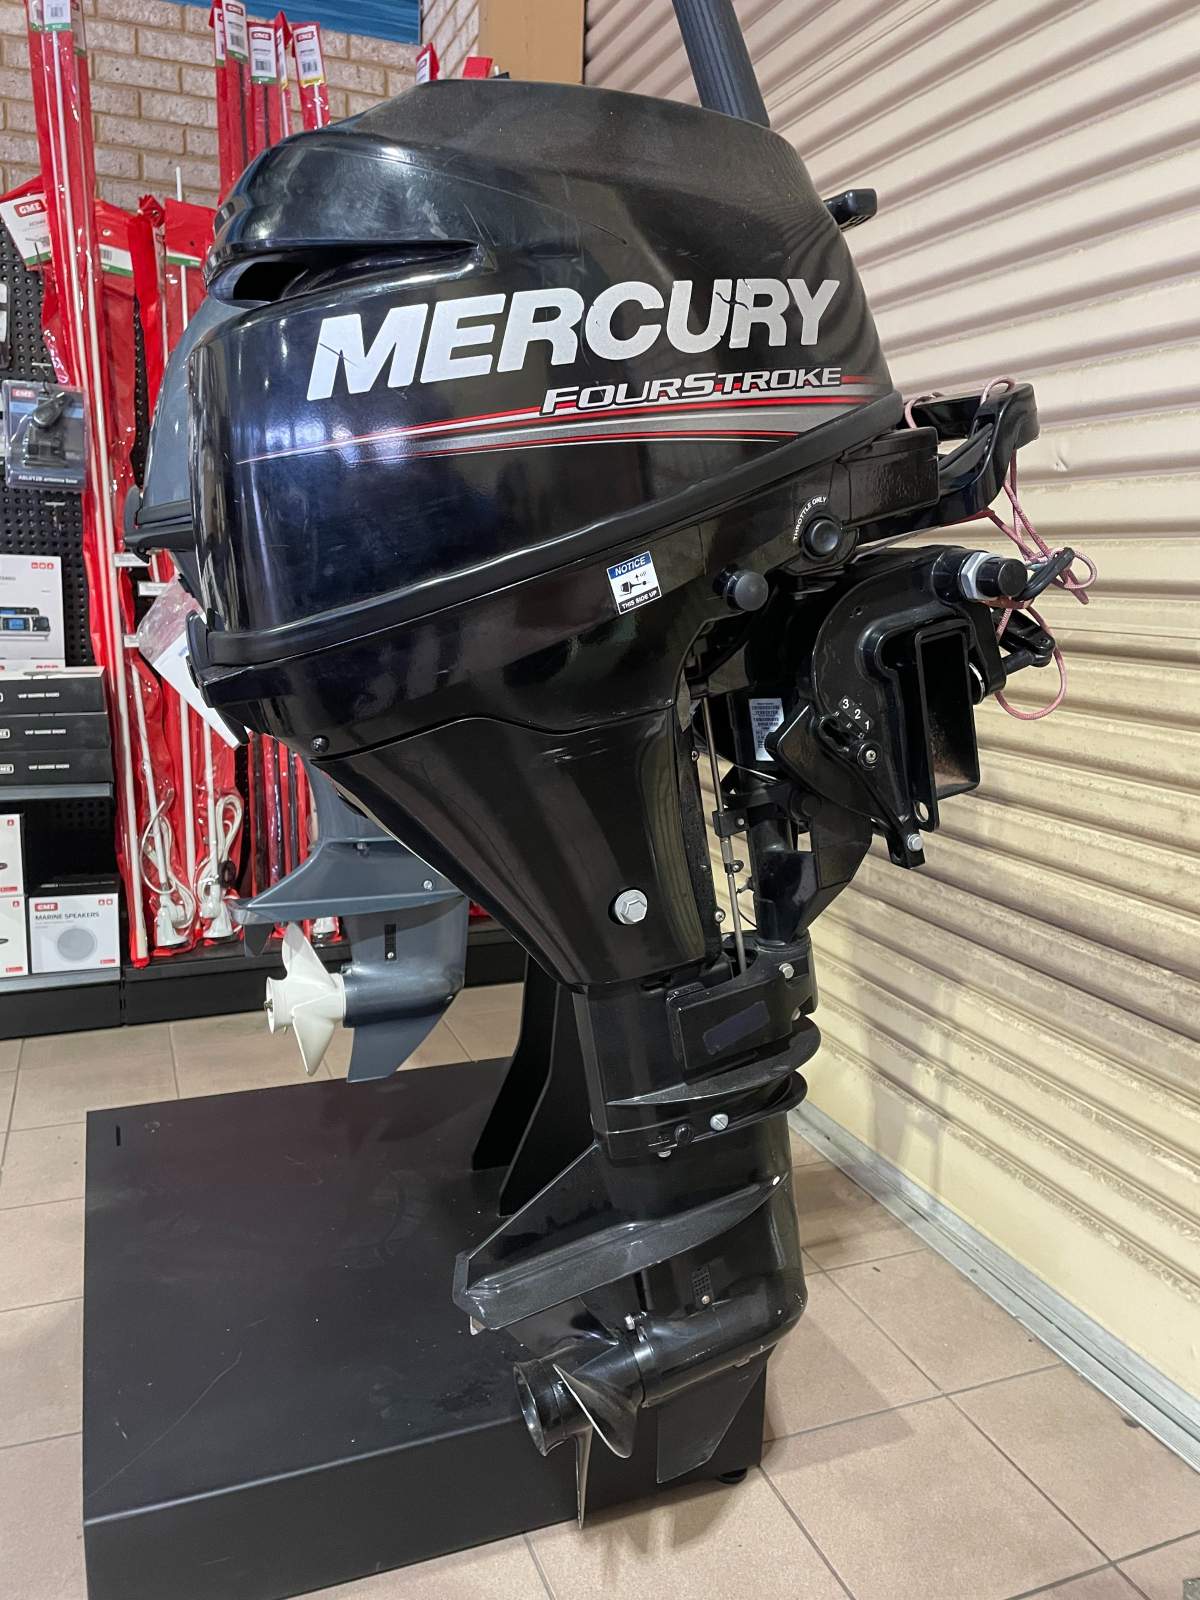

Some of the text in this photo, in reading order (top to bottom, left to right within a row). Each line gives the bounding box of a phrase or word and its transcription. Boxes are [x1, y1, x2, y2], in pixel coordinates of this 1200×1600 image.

[19, 202, 42, 214] GME
[306, 278, 841, 401] MERCURY
[540, 367, 842, 416] FOURSTROKE
[792, 496, 827, 542] THROTTLE ONLY
[614, 556, 646, 576] NOTICE
[622, 590, 658, 609] THIS SIDE UP
[842, 698, 870, 730] 3 2 1
